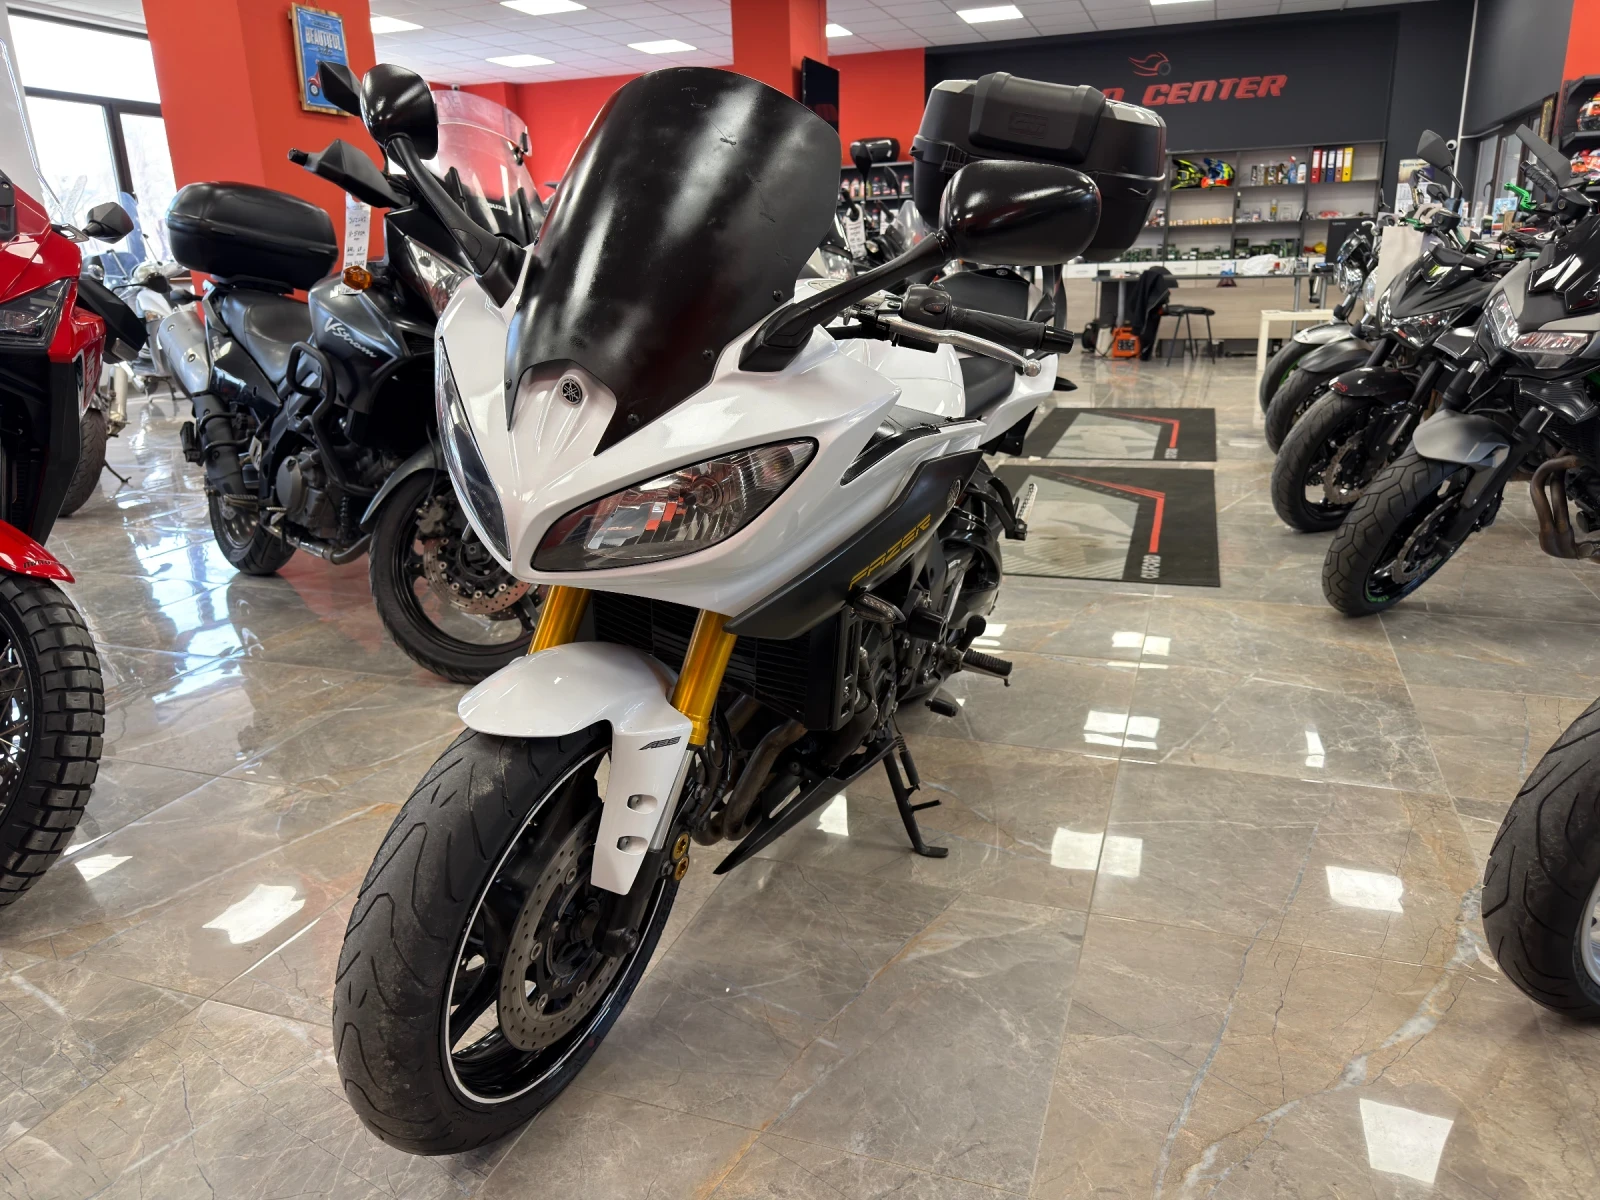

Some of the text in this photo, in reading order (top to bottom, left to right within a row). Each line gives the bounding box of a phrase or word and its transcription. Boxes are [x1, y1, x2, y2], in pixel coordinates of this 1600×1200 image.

[305, 27, 343, 51] BEAUTIFUL
[1141, 74, 1288, 107] CENTER
[848, 513, 931, 591] FAZER
[1140, 554, 1162, 579] OXFORD
[638, 736, 682, 751] ABS
